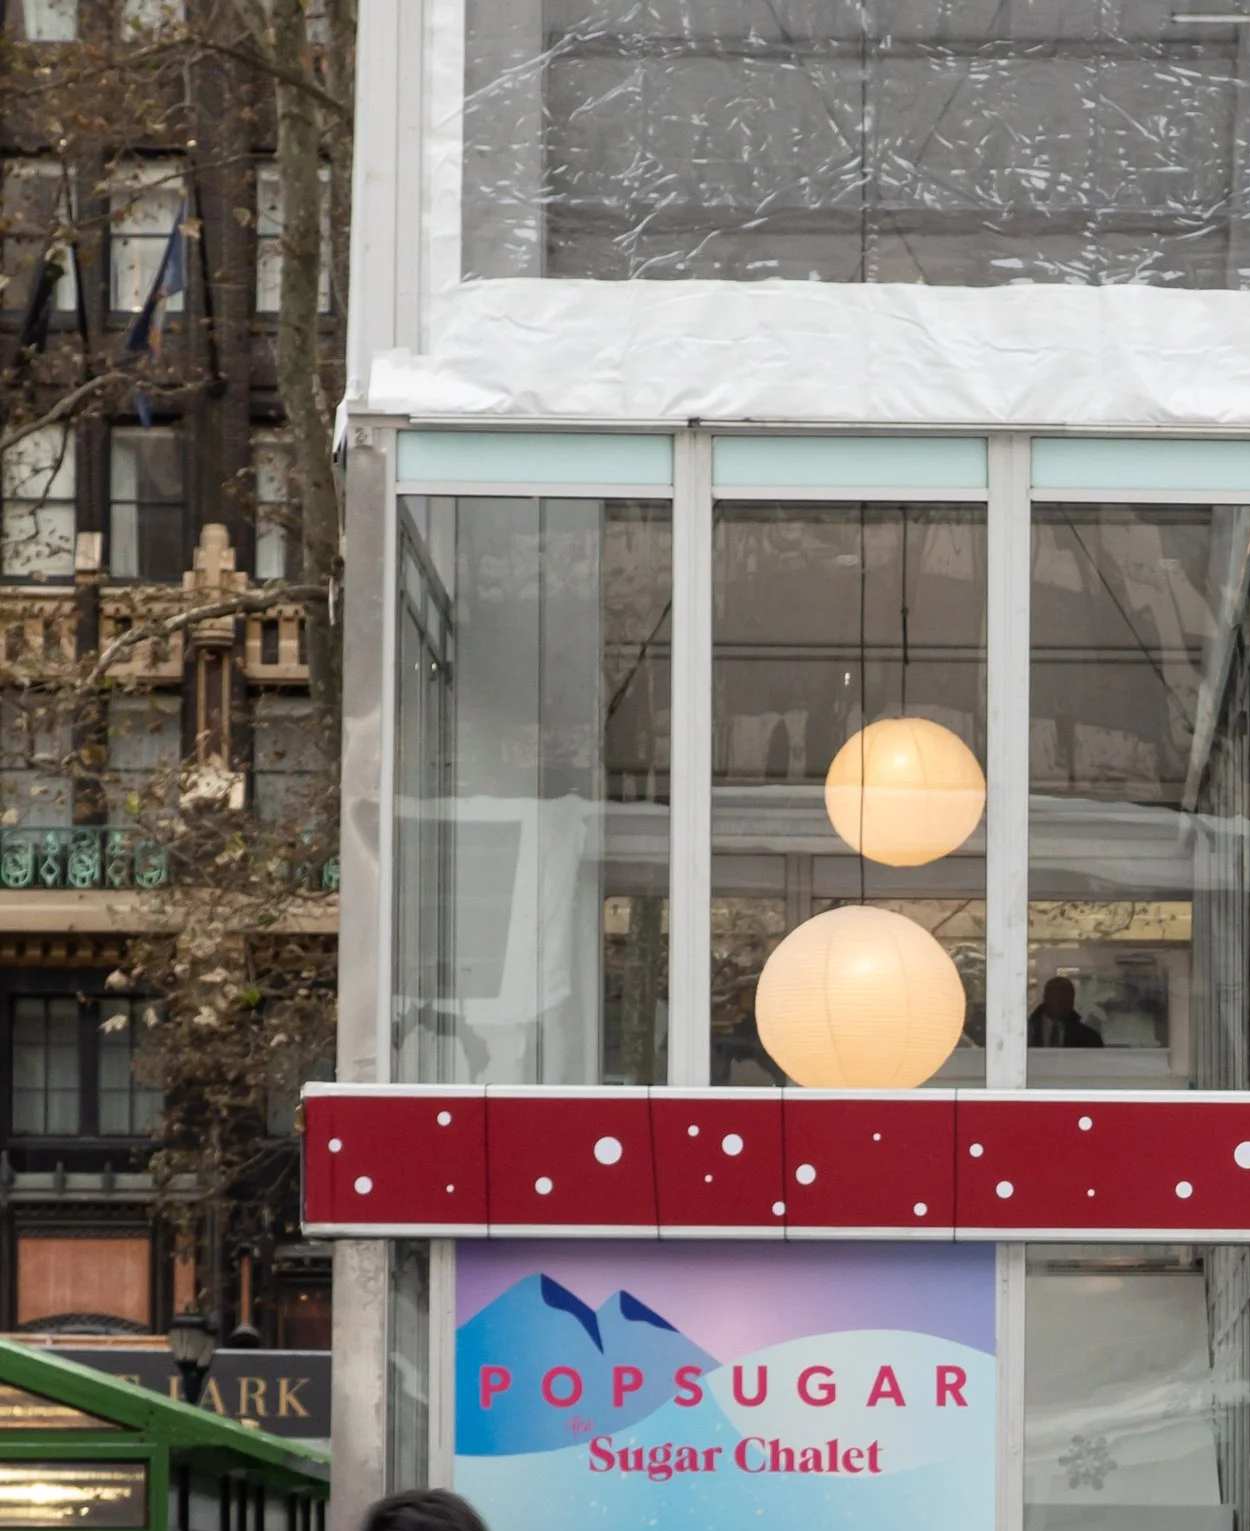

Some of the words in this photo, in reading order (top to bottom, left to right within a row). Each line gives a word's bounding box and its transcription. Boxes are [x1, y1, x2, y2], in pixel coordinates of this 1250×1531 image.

[480, 1365, 968, 1408] POPSUGAR
[589, 1436, 723, 1481] Sugar
[734, 1436, 884, 1474] Chalet
